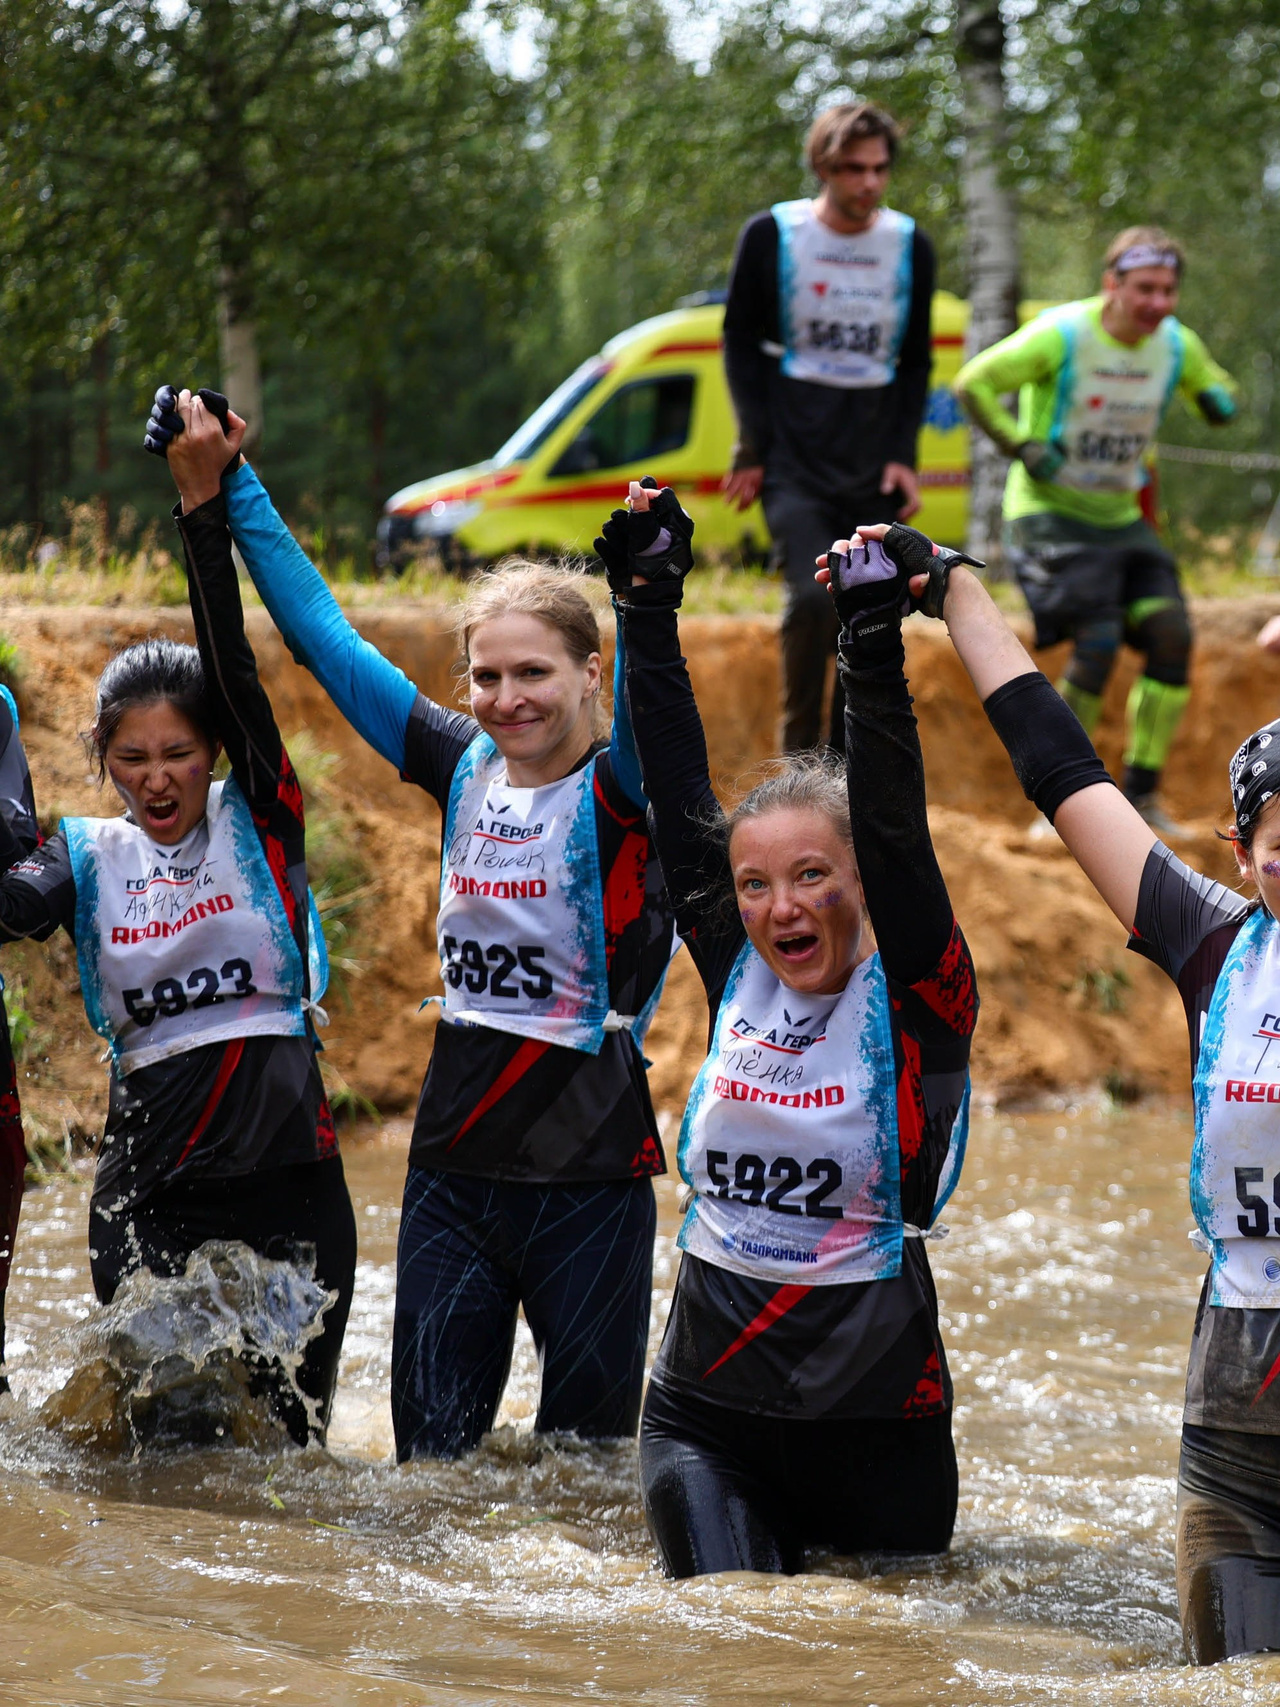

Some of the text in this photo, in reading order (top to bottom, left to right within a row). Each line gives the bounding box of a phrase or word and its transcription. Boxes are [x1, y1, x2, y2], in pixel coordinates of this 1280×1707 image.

[489, 820, 544, 840] ГЕРОВ
[126, 866, 164, 891] ГОА
[443, 934, 553, 1000] 5925
[122, 957, 258, 1028] 5923
[706, 1149, 844, 1219] 5922
[741, 1240, 818, 1264] ГАЗПРОМБАНК
